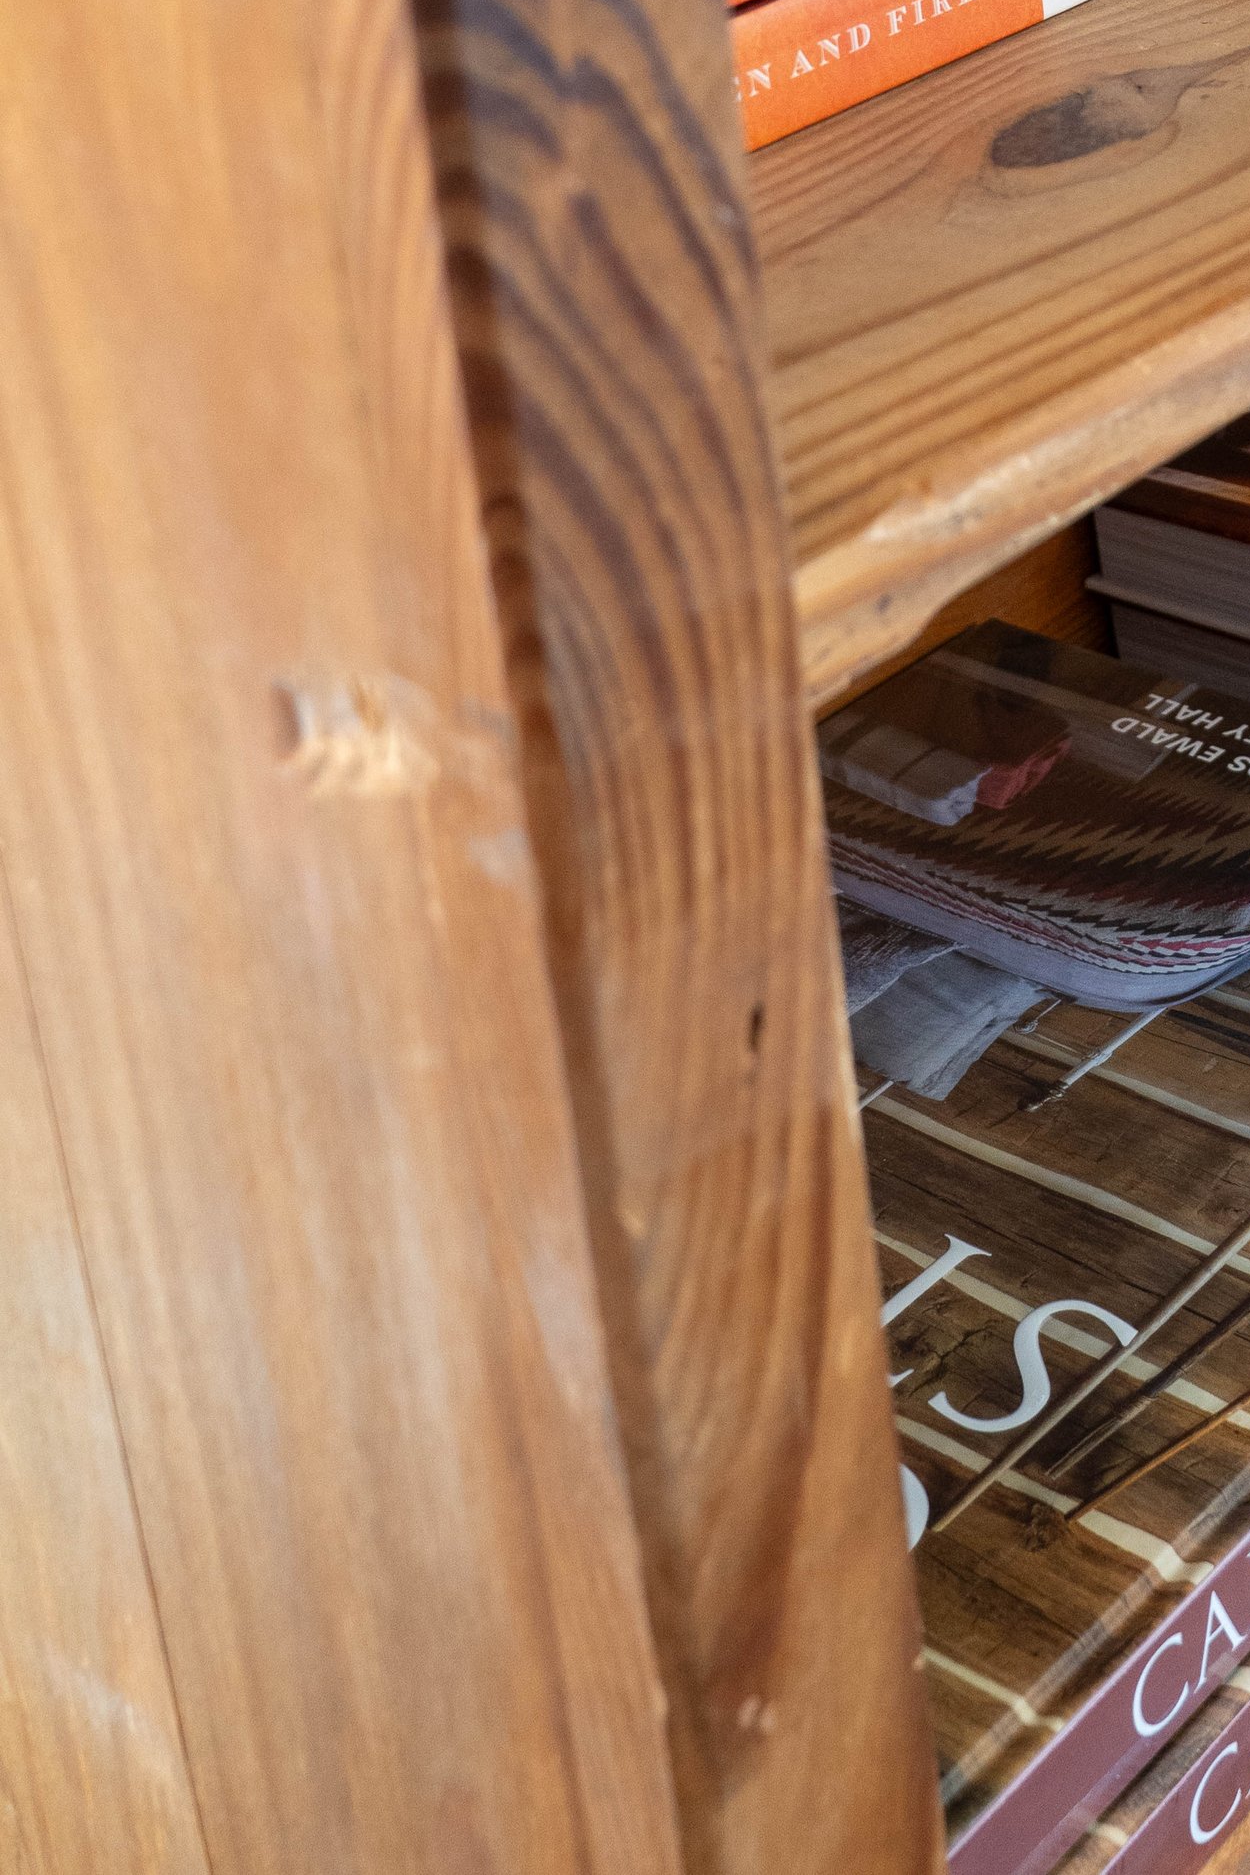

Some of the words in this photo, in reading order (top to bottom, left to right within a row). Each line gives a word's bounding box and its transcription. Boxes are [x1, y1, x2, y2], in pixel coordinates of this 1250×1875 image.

[789, 22, 872, 79] AND
[1144, 692, 1226, 730] HALL
[1111, 716, 1226, 764] EWALD
